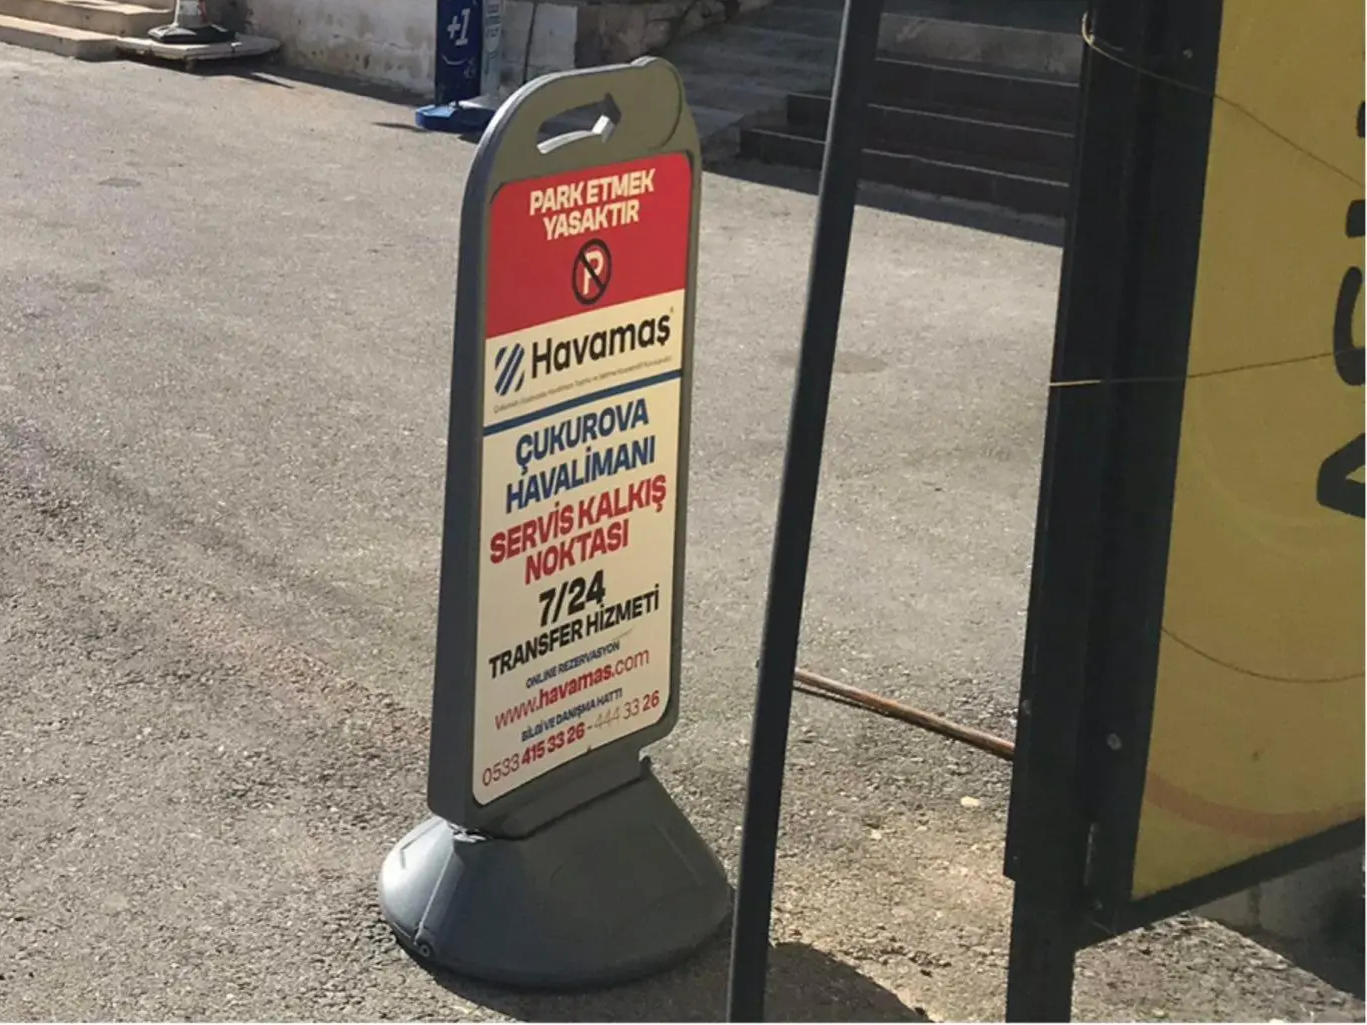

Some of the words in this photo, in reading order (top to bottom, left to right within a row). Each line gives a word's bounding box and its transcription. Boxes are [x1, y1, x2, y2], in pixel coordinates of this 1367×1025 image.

[529, 179, 584, 216] PARK
[586, 168, 656, 205] ETMEK
[543, 200, 640, 241] YASAKTIR
[531, 313, 671, 379] Havamaş
[515, 398, 649, 473] ÇUKUROVA
[506, 435, 656, 513] HAVALİMANI
[490, 501, 574, 564] SERVİS
[577, 474, 666, 529] KALKIŞ
[525, 519, 629, 585] NOKTASI
[489, 617, 582, 678] TRANSFER
[585, 583, 660, 636] HİZMETİ
[539, 569, 606, 628] 7/24
[494, 649, 650, 730] www.havamas.com
[558, 640, 621, 674] REZERVASYON
[482, 753, 520, 787] 0533
[521, 739, 545, 765] 415
[546, 731, 565, 753] 33
[566, 722, 585, 745] 26
[622, 698, 639, 720] 33
[642, 690, 660, 712] 26
